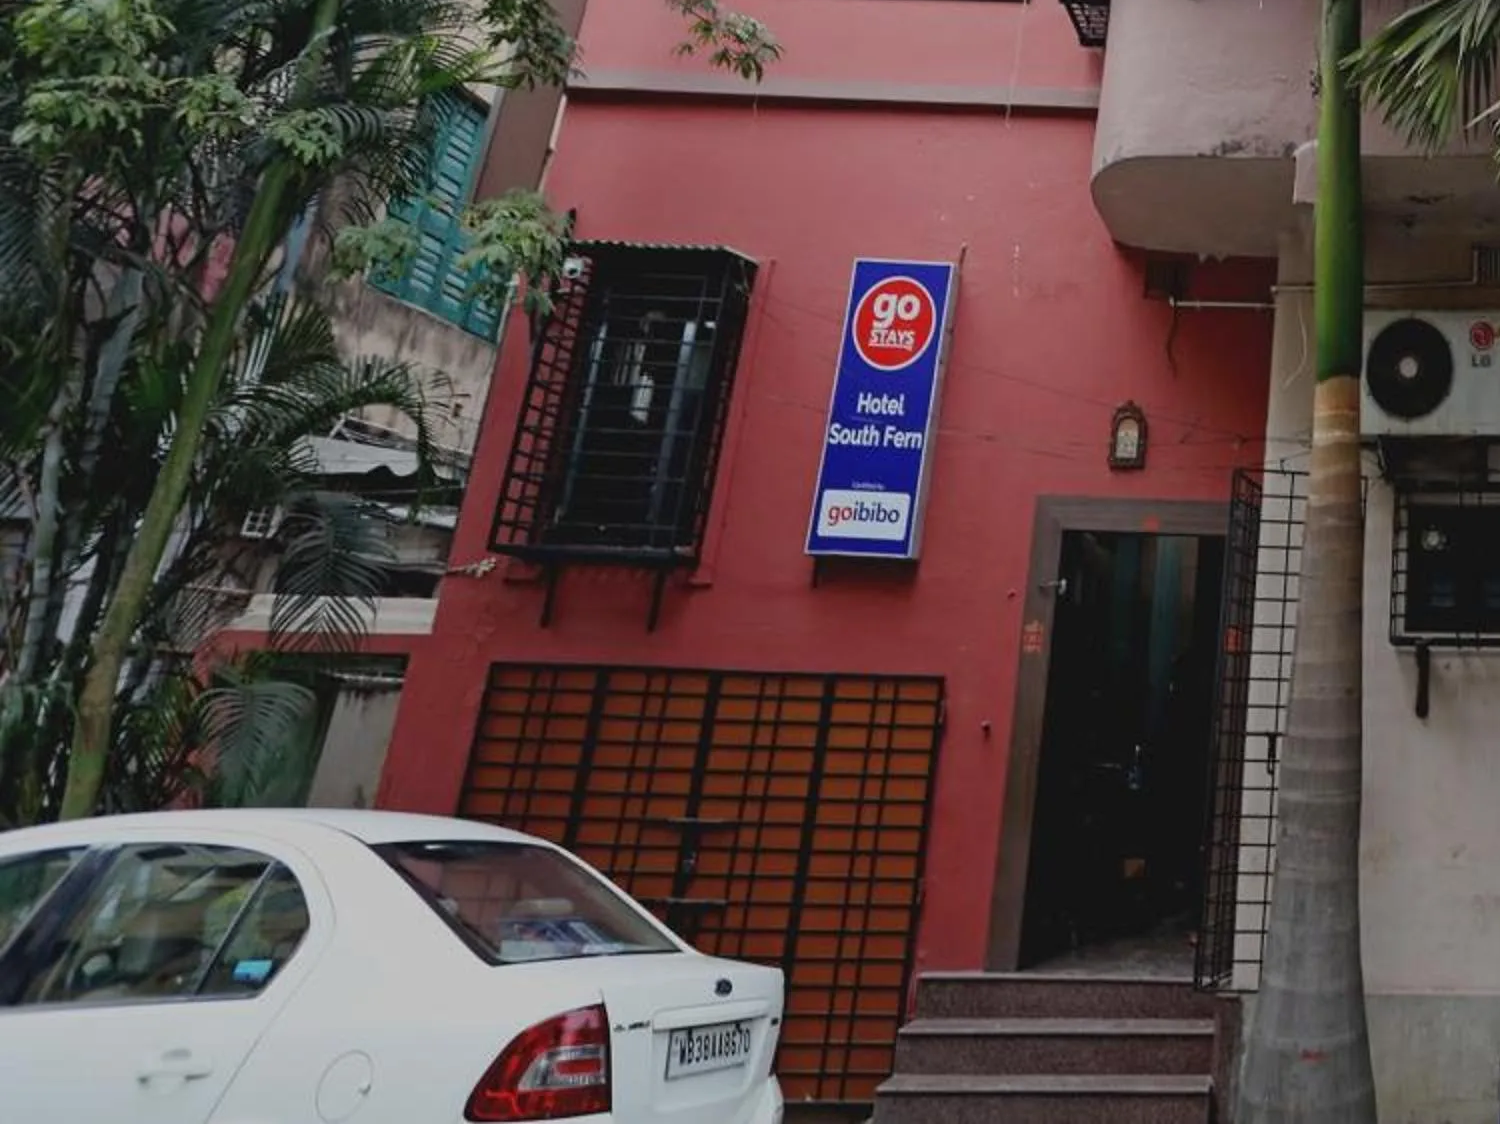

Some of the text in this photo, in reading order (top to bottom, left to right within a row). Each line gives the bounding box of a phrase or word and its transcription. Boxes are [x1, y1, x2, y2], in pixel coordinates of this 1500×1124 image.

[873, 292, 920, 329] go
[869, 329, 915, 346] STAYS
[857, 393, 904, 417] Hotel
[828, 423, 923, 449] South Fern
[828, 500, 900, 526] goibibo
